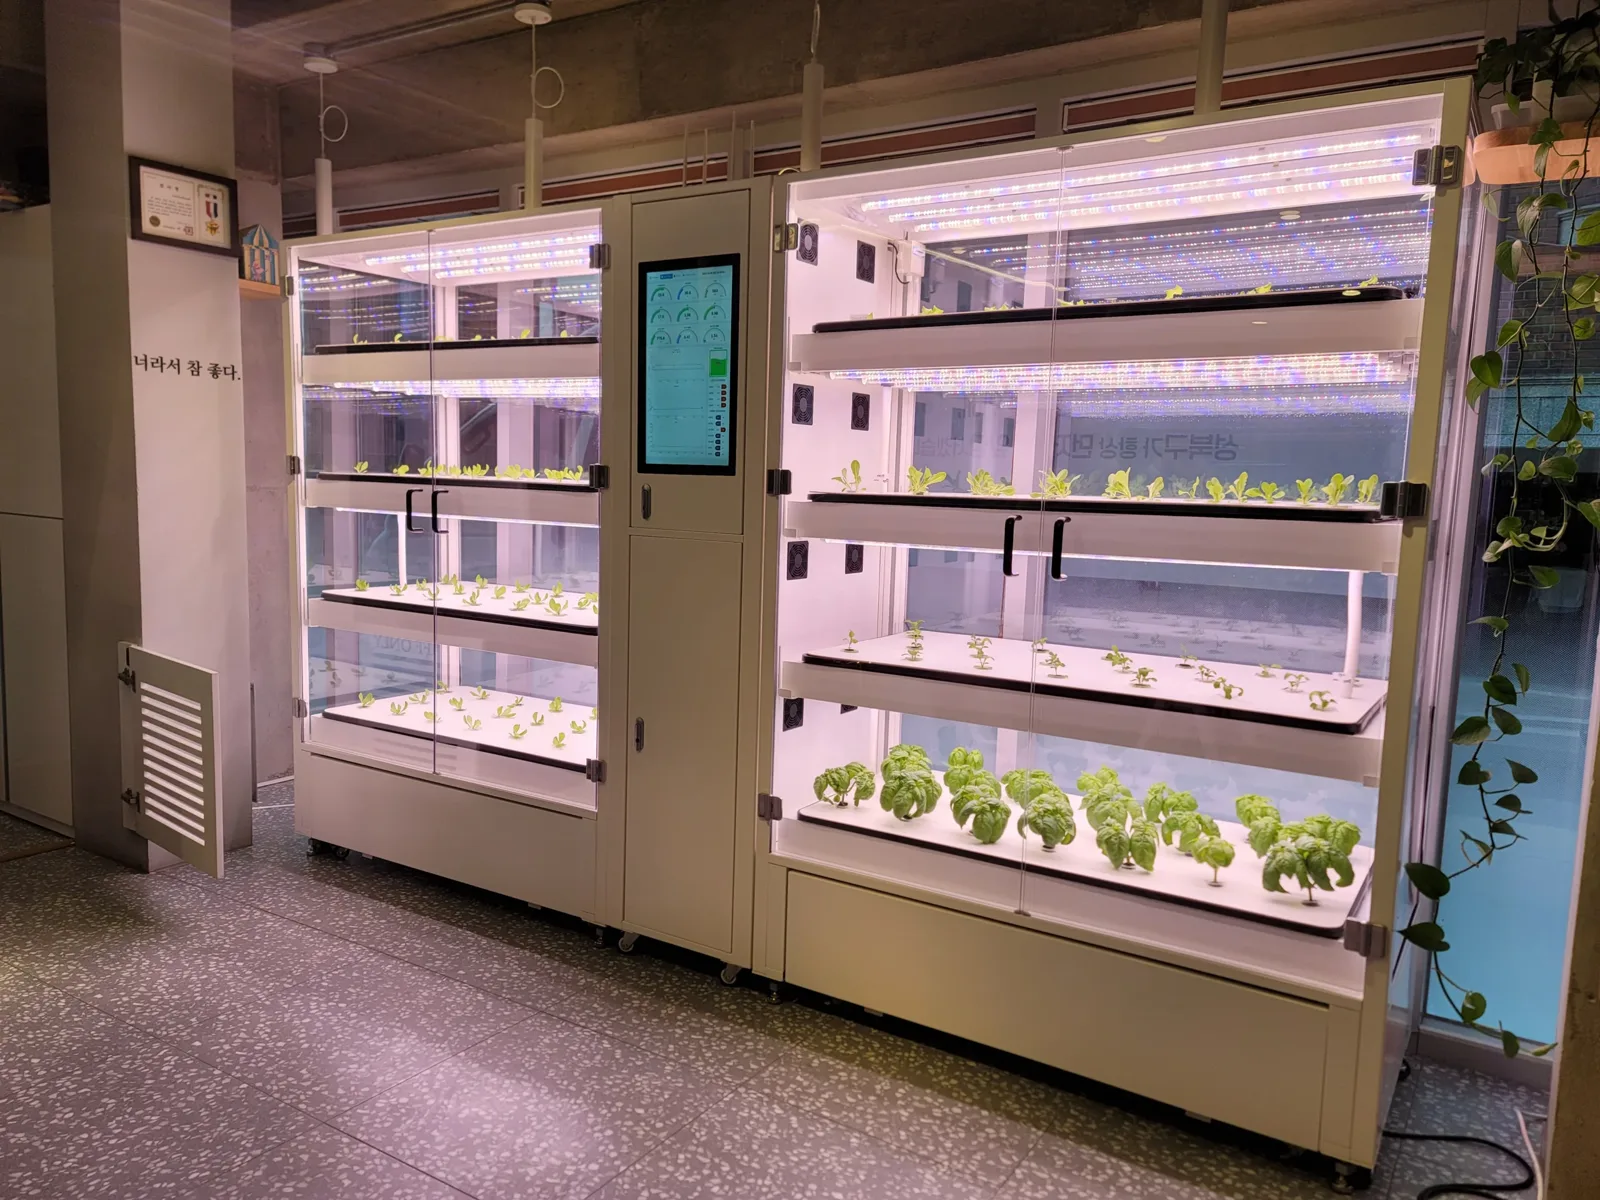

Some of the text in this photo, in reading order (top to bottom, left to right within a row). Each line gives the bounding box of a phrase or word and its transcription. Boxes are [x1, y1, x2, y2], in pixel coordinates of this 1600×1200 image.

[133, 353, 241, 381] 너라서 참 좋다.
